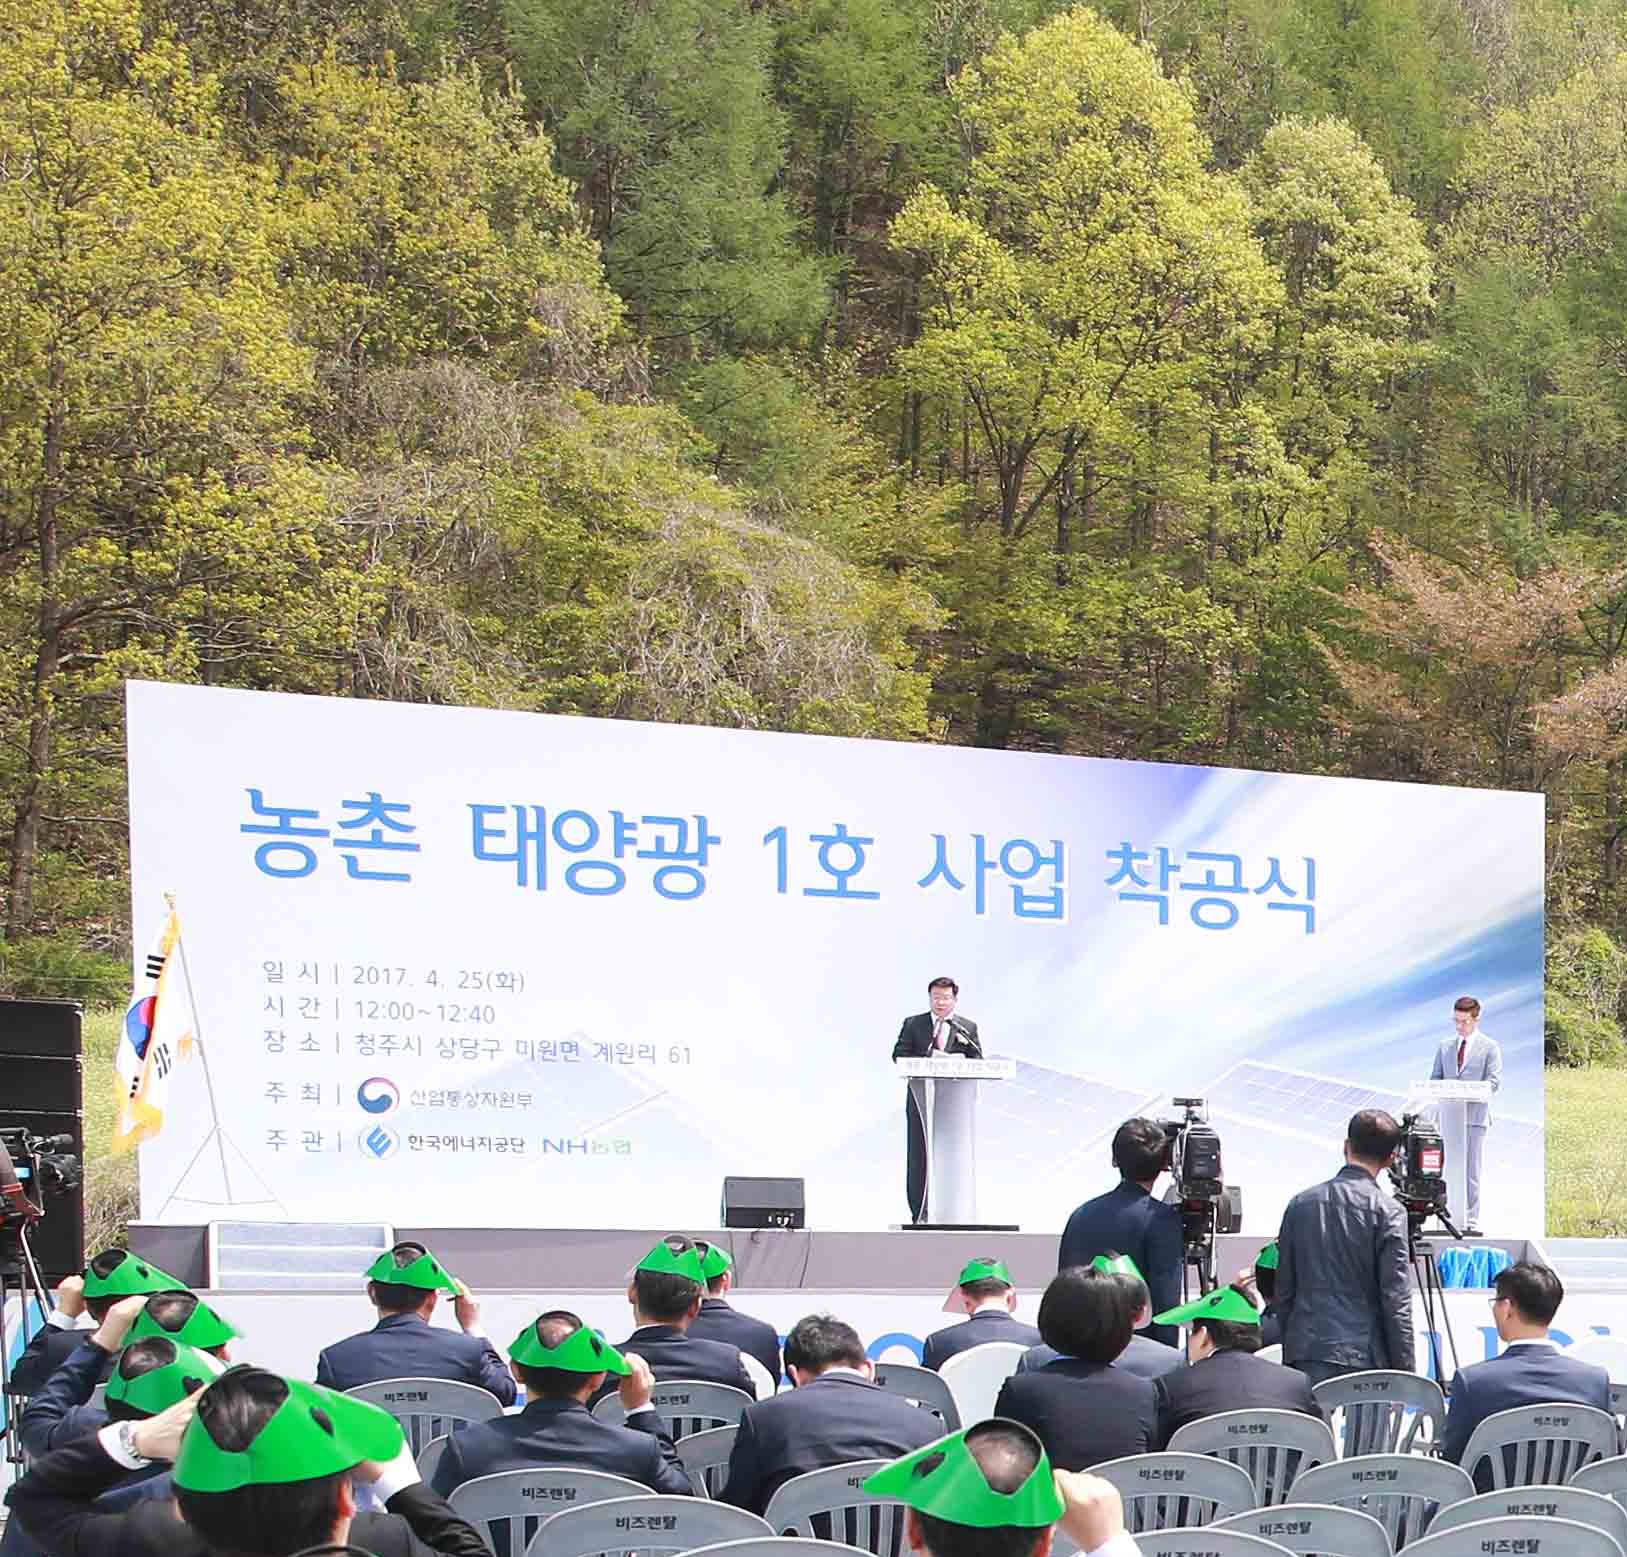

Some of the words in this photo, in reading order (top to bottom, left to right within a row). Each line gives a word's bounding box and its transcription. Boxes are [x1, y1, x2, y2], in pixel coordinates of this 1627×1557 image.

[240, 788, 421, 882] 농촌
[466, 803, 721, 900] 태양광
[762, 823, 881, 900] 1호
[917, 832, 1065, 920] 사업
[1104, 840, 1316, 935] 착공식
[353, 966, 414, 987] 2017.
[426, 971, 449, 989] 4.
[458, 970, 526, 992] 25(화)
[355, 1001, 496, 1024] 12:00~12:40
[354, 1034, 423, 1058] 청주시
[435, 1037, 503, 1061] 상당구
[515, 1039, 581, 1064] 미원면
[593, 1041, 656, 1066] 계원리
[668, 1047, 692, 1065] 61
[409, 1089, 533, 1109] 산업통상자원부
[408, 1134, 526, 1155] 한국에너지공단
[1138, 1469, 1185, 1482] 비즈렌탈
[1351, 1469, 1398, 1482] 비즈렌탈
[521, 1486, 576, 1501] 비즈렌탈
[1507, 1503, 1558, 1516] 비즈렌탈
[615, 1515, 678, 1531] 비즈렌탈
[1259, 1521, 1312, 1537] 비즈렌탈
[1481, 1537, 1541, 1555] 비즈렌탈
